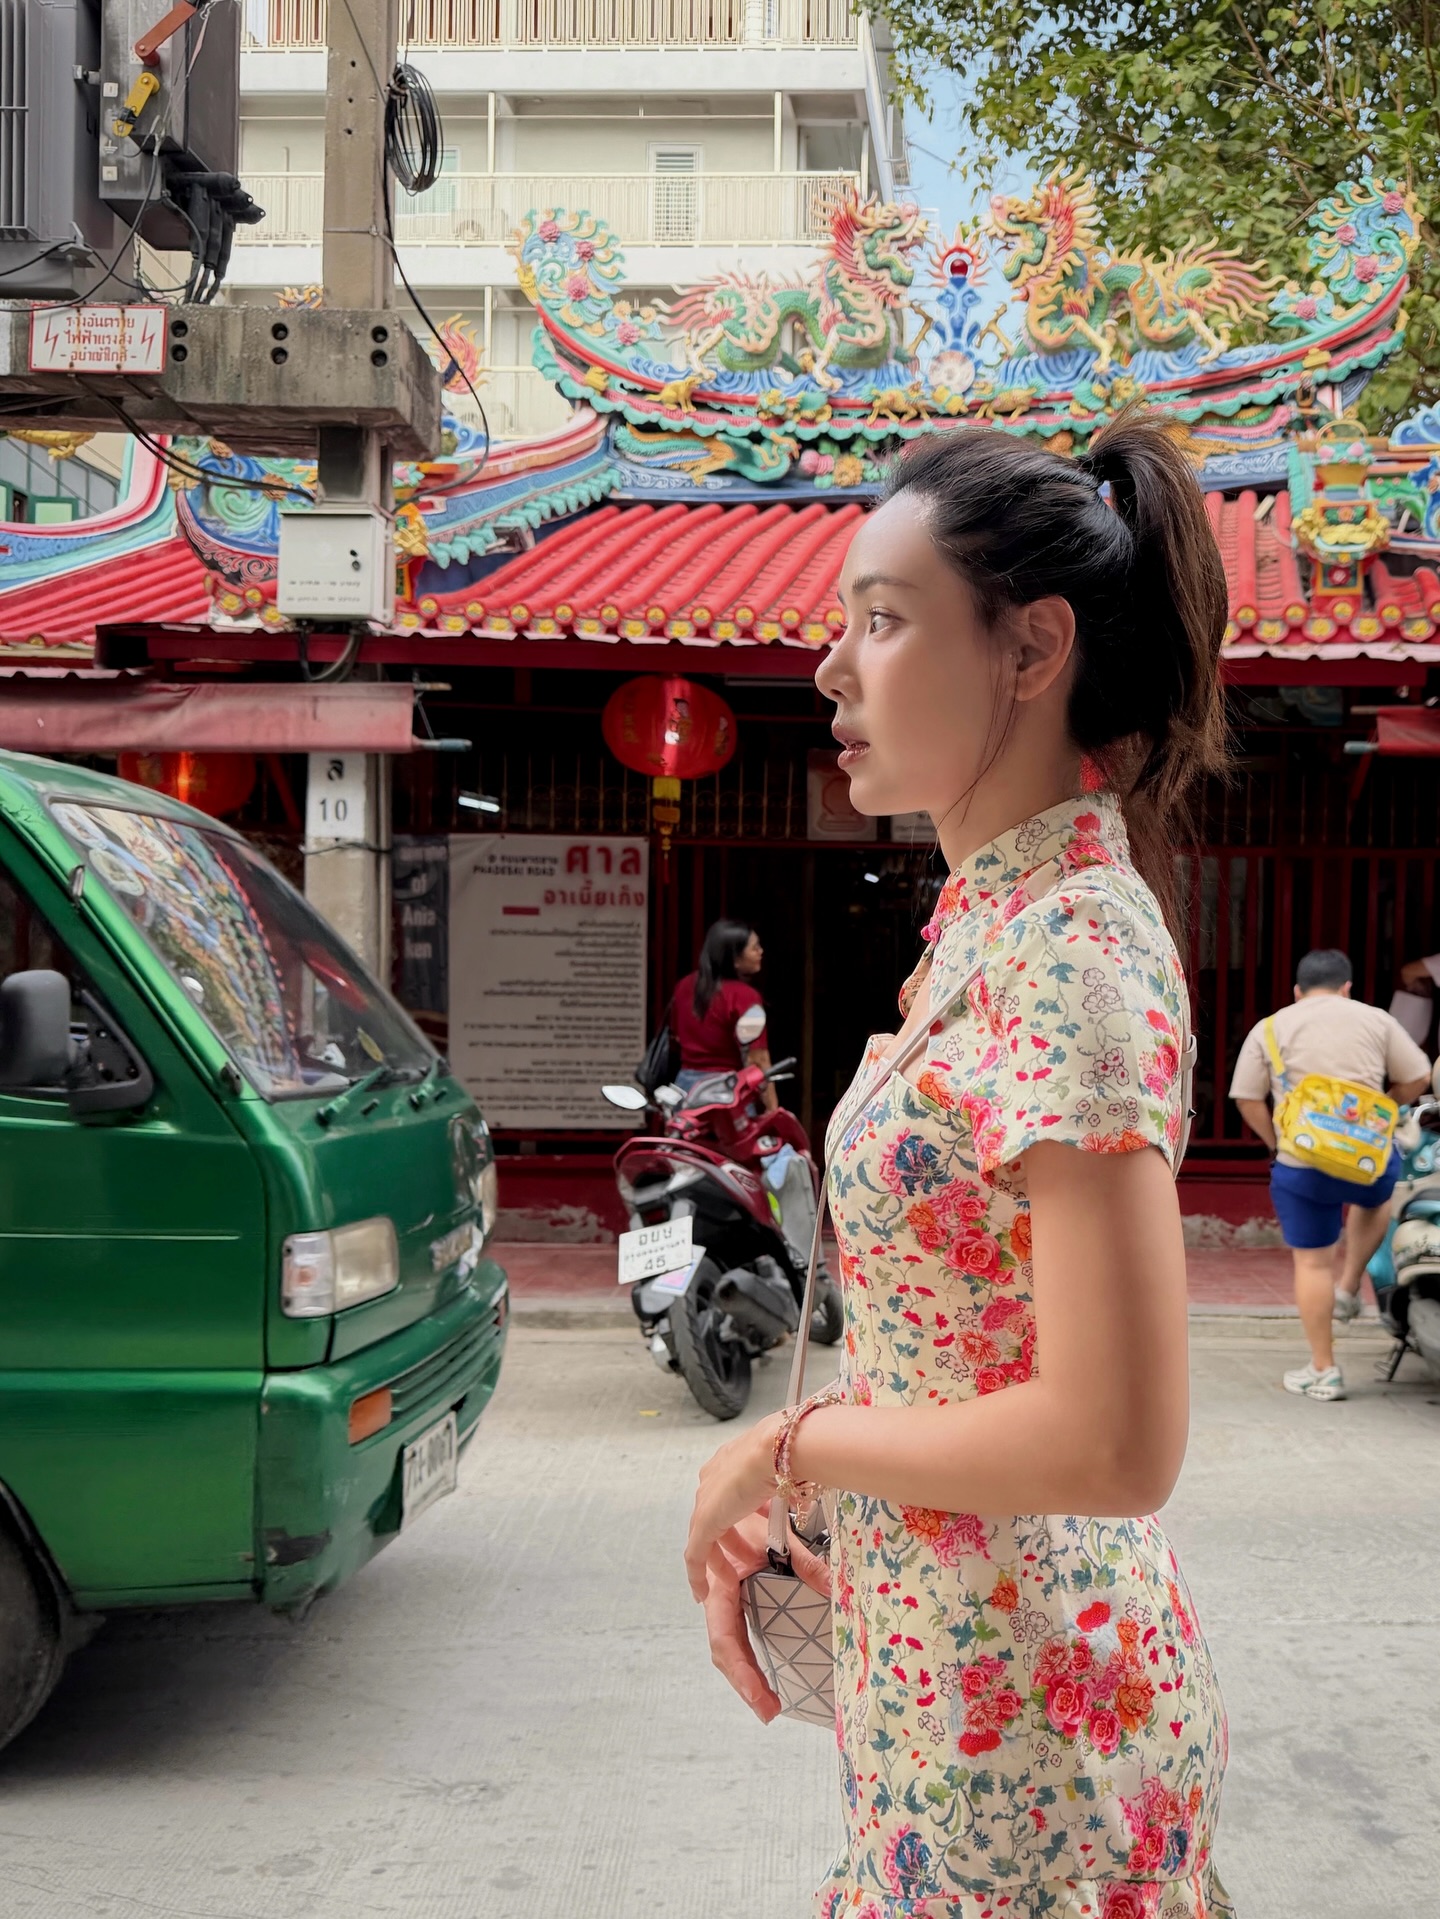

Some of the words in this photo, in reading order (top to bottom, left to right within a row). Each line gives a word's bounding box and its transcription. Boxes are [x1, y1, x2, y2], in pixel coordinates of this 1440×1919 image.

[319, 798, 348, 821] 10
[566, 844, 642, 876] ศาล
[527, 866, 556, 878] ROAD
